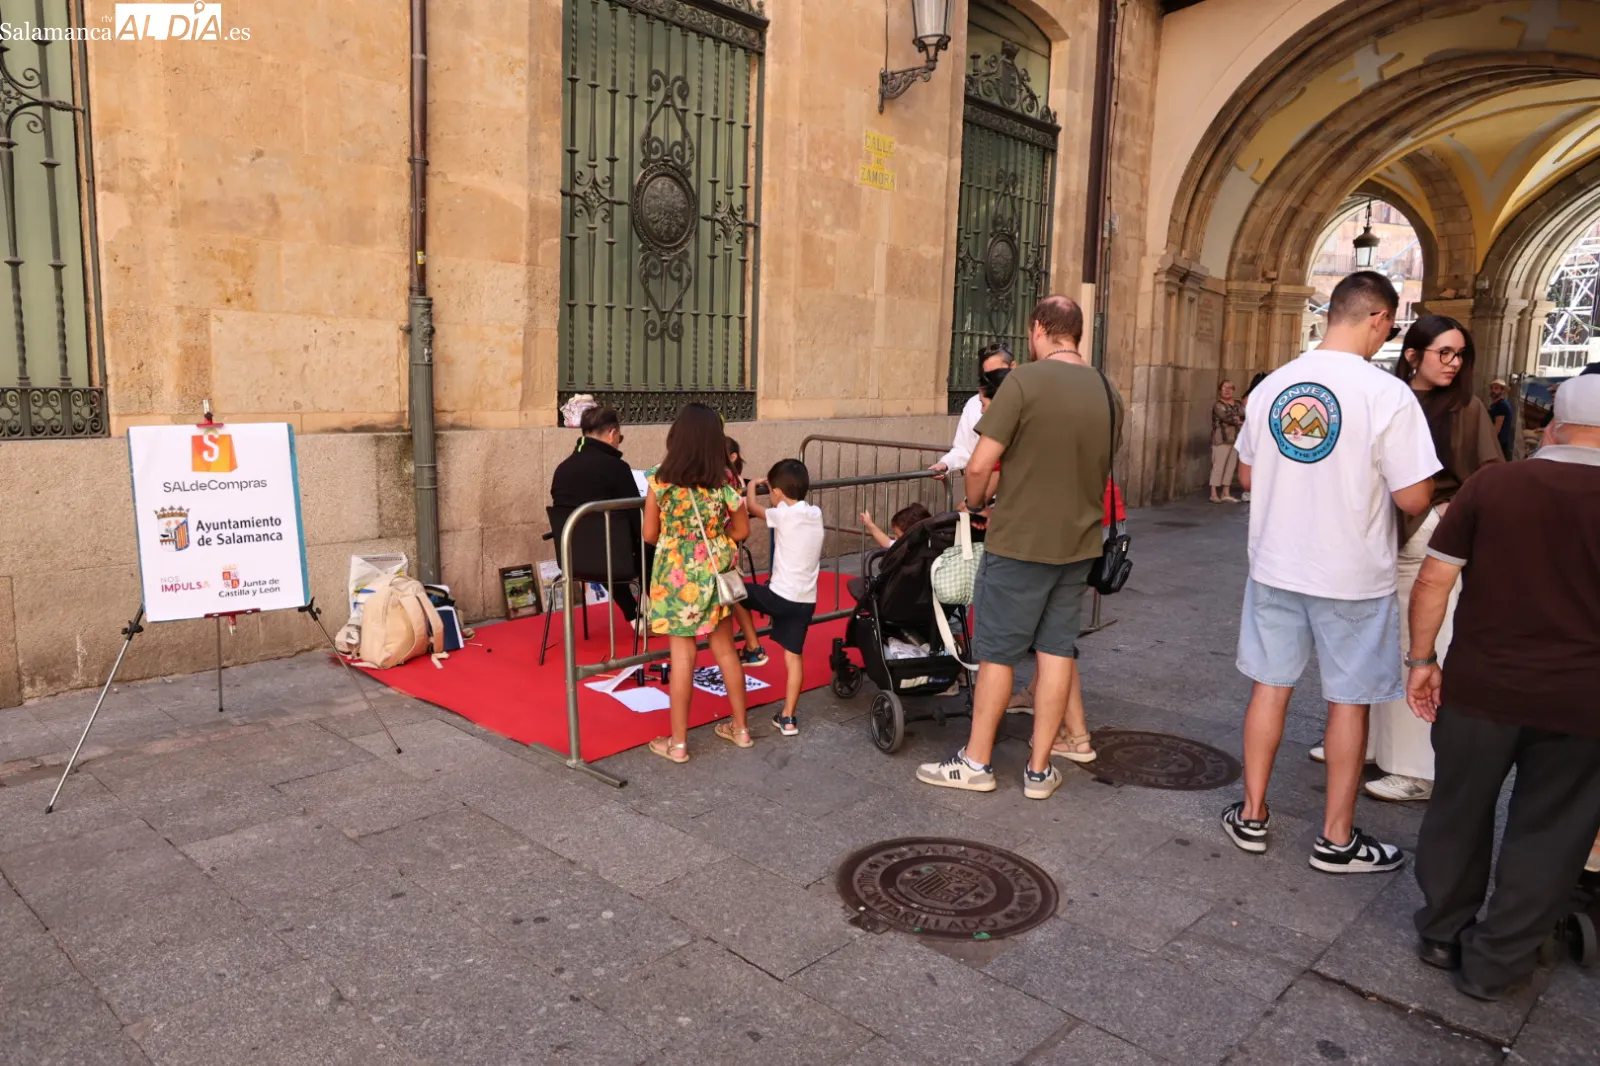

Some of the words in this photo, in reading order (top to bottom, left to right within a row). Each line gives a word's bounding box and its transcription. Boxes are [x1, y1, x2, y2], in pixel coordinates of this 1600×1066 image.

[865, 134, 895, 155] CALLE
[860, 166, 896, 189] ZAMORA
[1272, 386, 1338, 424] CONVERSE
[1293, 450, 1310, 458] THE
[163, 479, 267, 492] SALdeCompras
[196, 516, 282, 533] Ayuntamiento
[197, 535, 212, 546] de
[217, 531, 283, 546] Salamanca
[160, 575, 180, 583] NOS
[243, 579, 267, 588] Junta
[269, 578, 280, 586] de
[218, 588, 250, 598] Castilla
[252, 588, 257, 597] y
[259, 584, 281, 594] León
